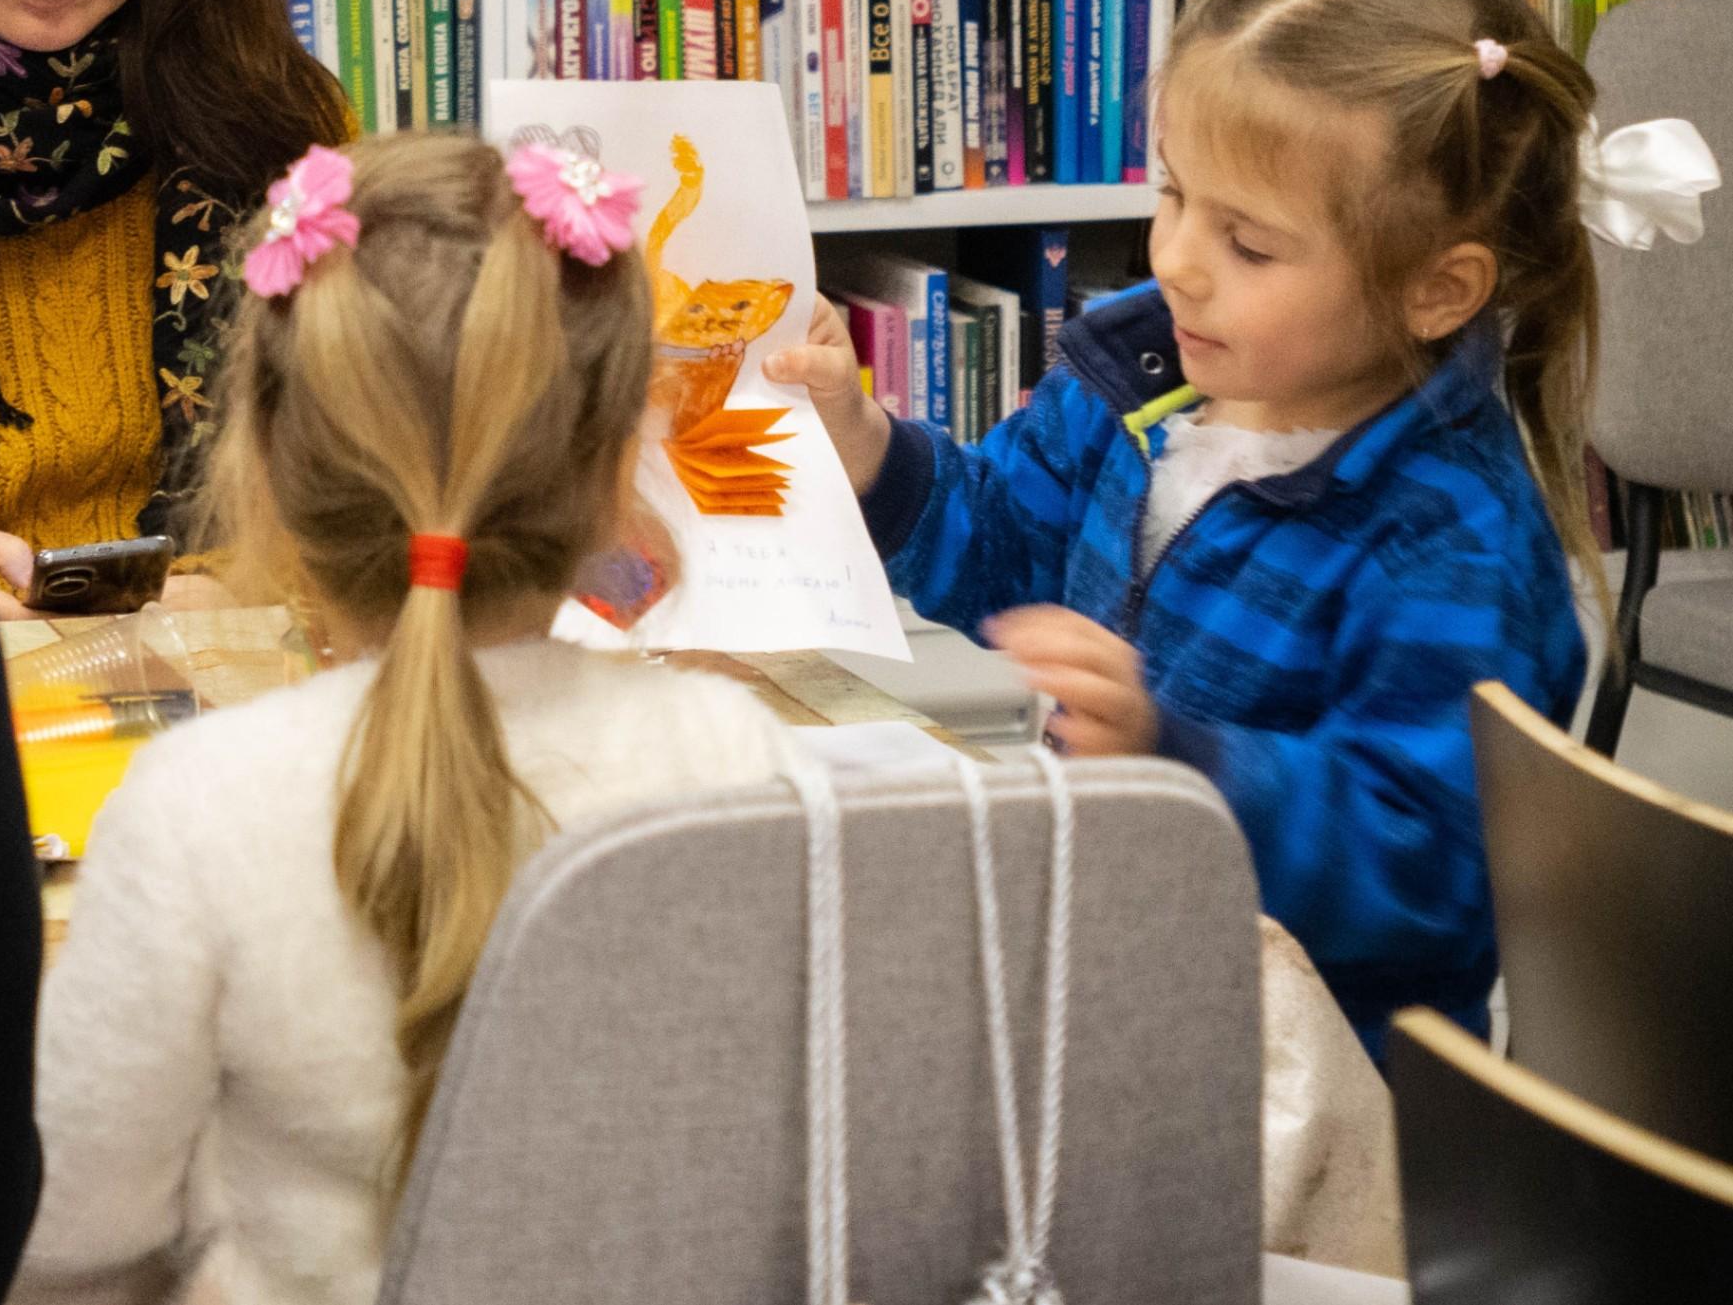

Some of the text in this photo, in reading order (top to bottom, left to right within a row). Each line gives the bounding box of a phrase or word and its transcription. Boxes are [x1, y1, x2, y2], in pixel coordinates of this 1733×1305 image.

[875, 3, 889, 15] о
[870, 20, 890, 61] Все
[397, 47, 413, 91] КНИГА
[432, 22, 450, 121] ВАША КОШКА
[946, 24, 960, 113] МОЙ БРАТ
